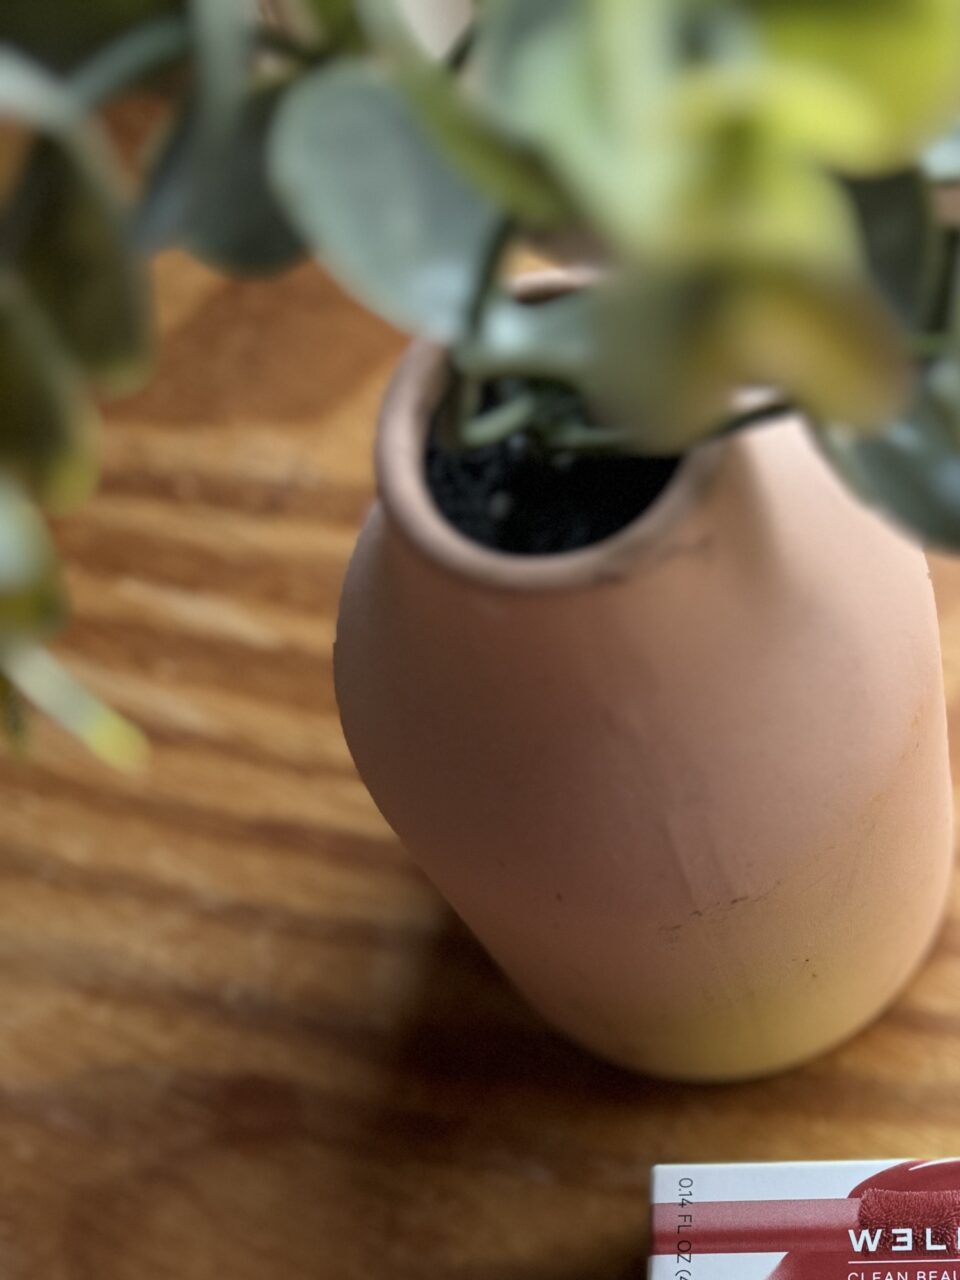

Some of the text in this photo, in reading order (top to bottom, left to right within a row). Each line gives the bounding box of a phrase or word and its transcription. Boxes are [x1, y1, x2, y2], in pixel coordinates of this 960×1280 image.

[678, 1178, 693, 1208] 0.14
[677, 1214, 692, 1234] FL
[676, 1240, 692, 1263] OZ
